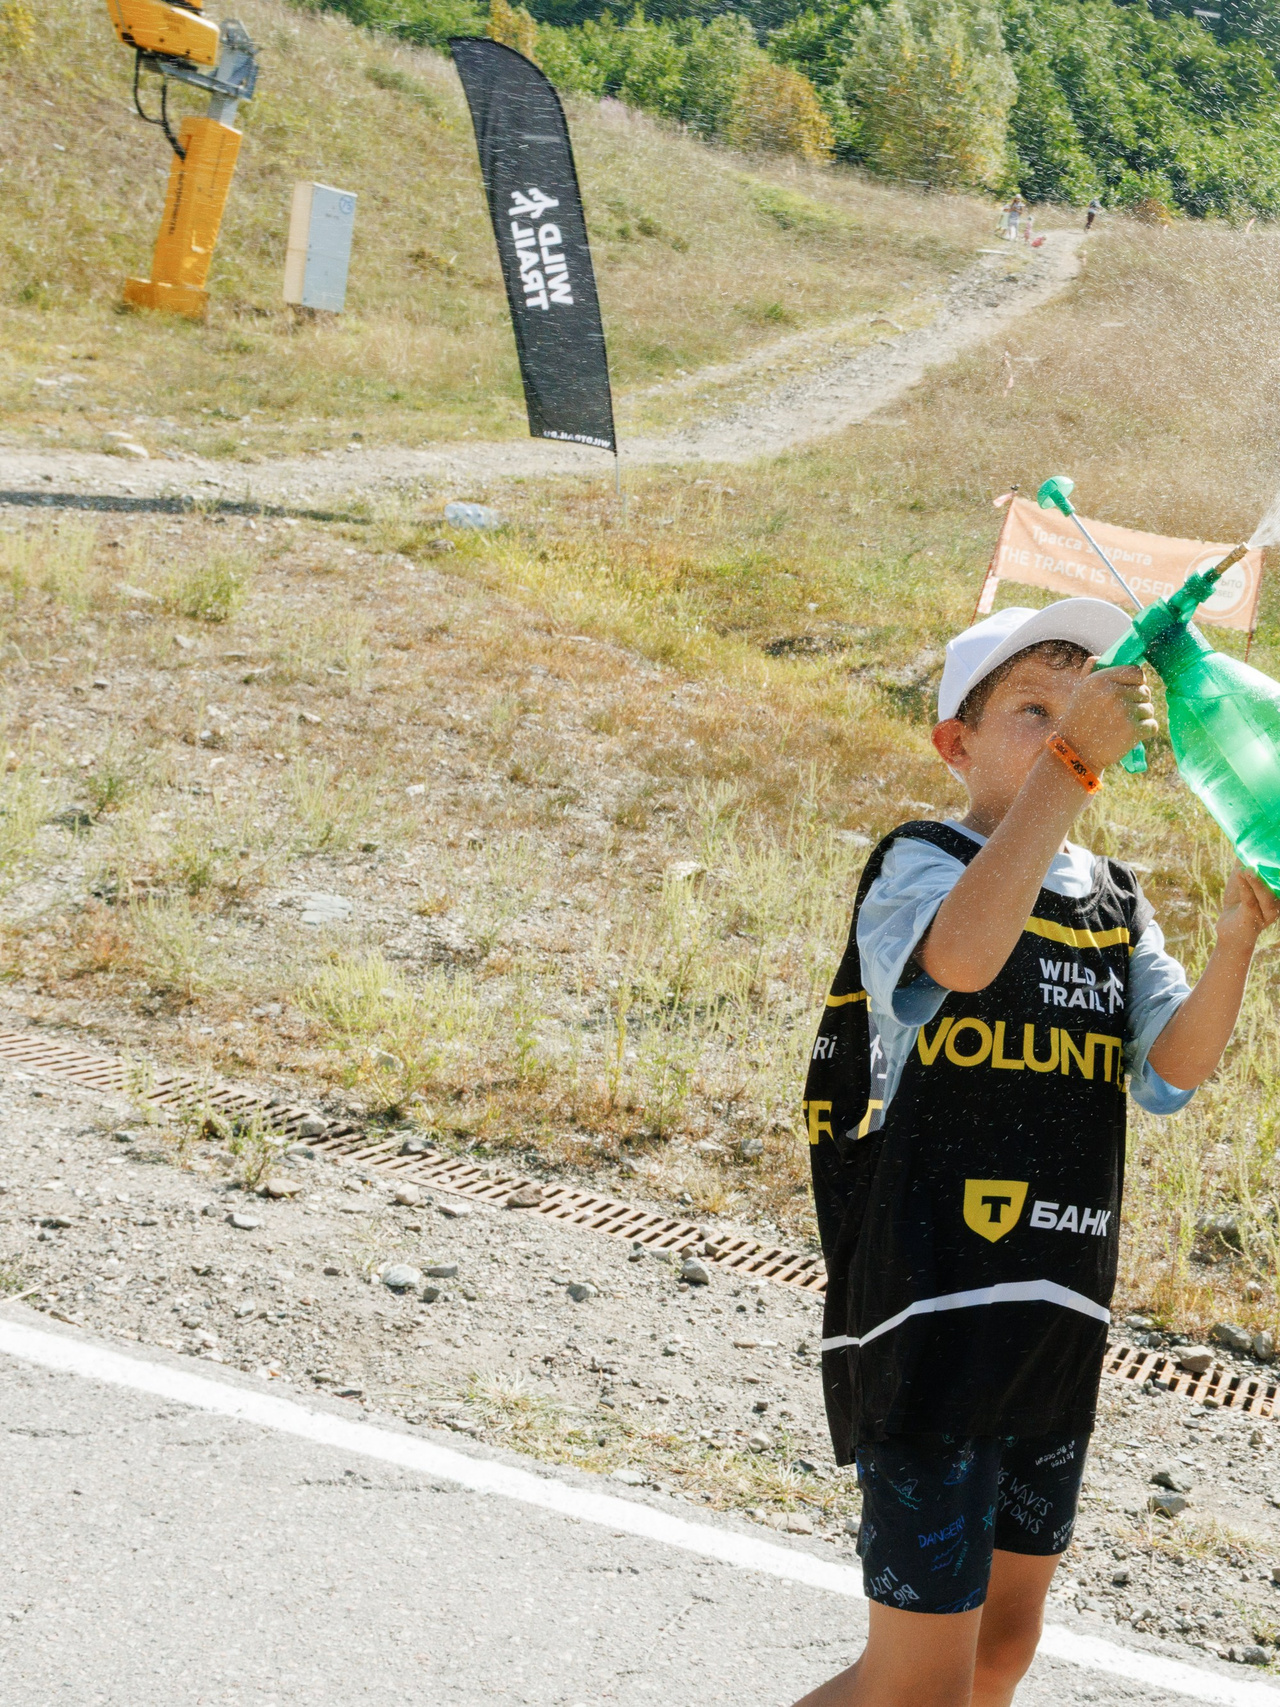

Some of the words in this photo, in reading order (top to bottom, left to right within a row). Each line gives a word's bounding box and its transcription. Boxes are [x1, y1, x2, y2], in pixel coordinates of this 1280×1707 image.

[1032, 525, 1083, 551] Трасса
[1000, 545, 1031, 567] THE
[1034, 553, 1087, 580] TRACK
[1089, 567, 1107, 584] IS
[1039, 957, 1096, 986] WILD
[1039, 982, 1105, 1013] TRAIL
[1029, 1200, 1111, 1237] БАНК
[1009, 1477, 1053, 1516] WAVES
[1010, 1504, 1044, 1534] DAYS
[870, 1566, 899, 1596] LAZY
